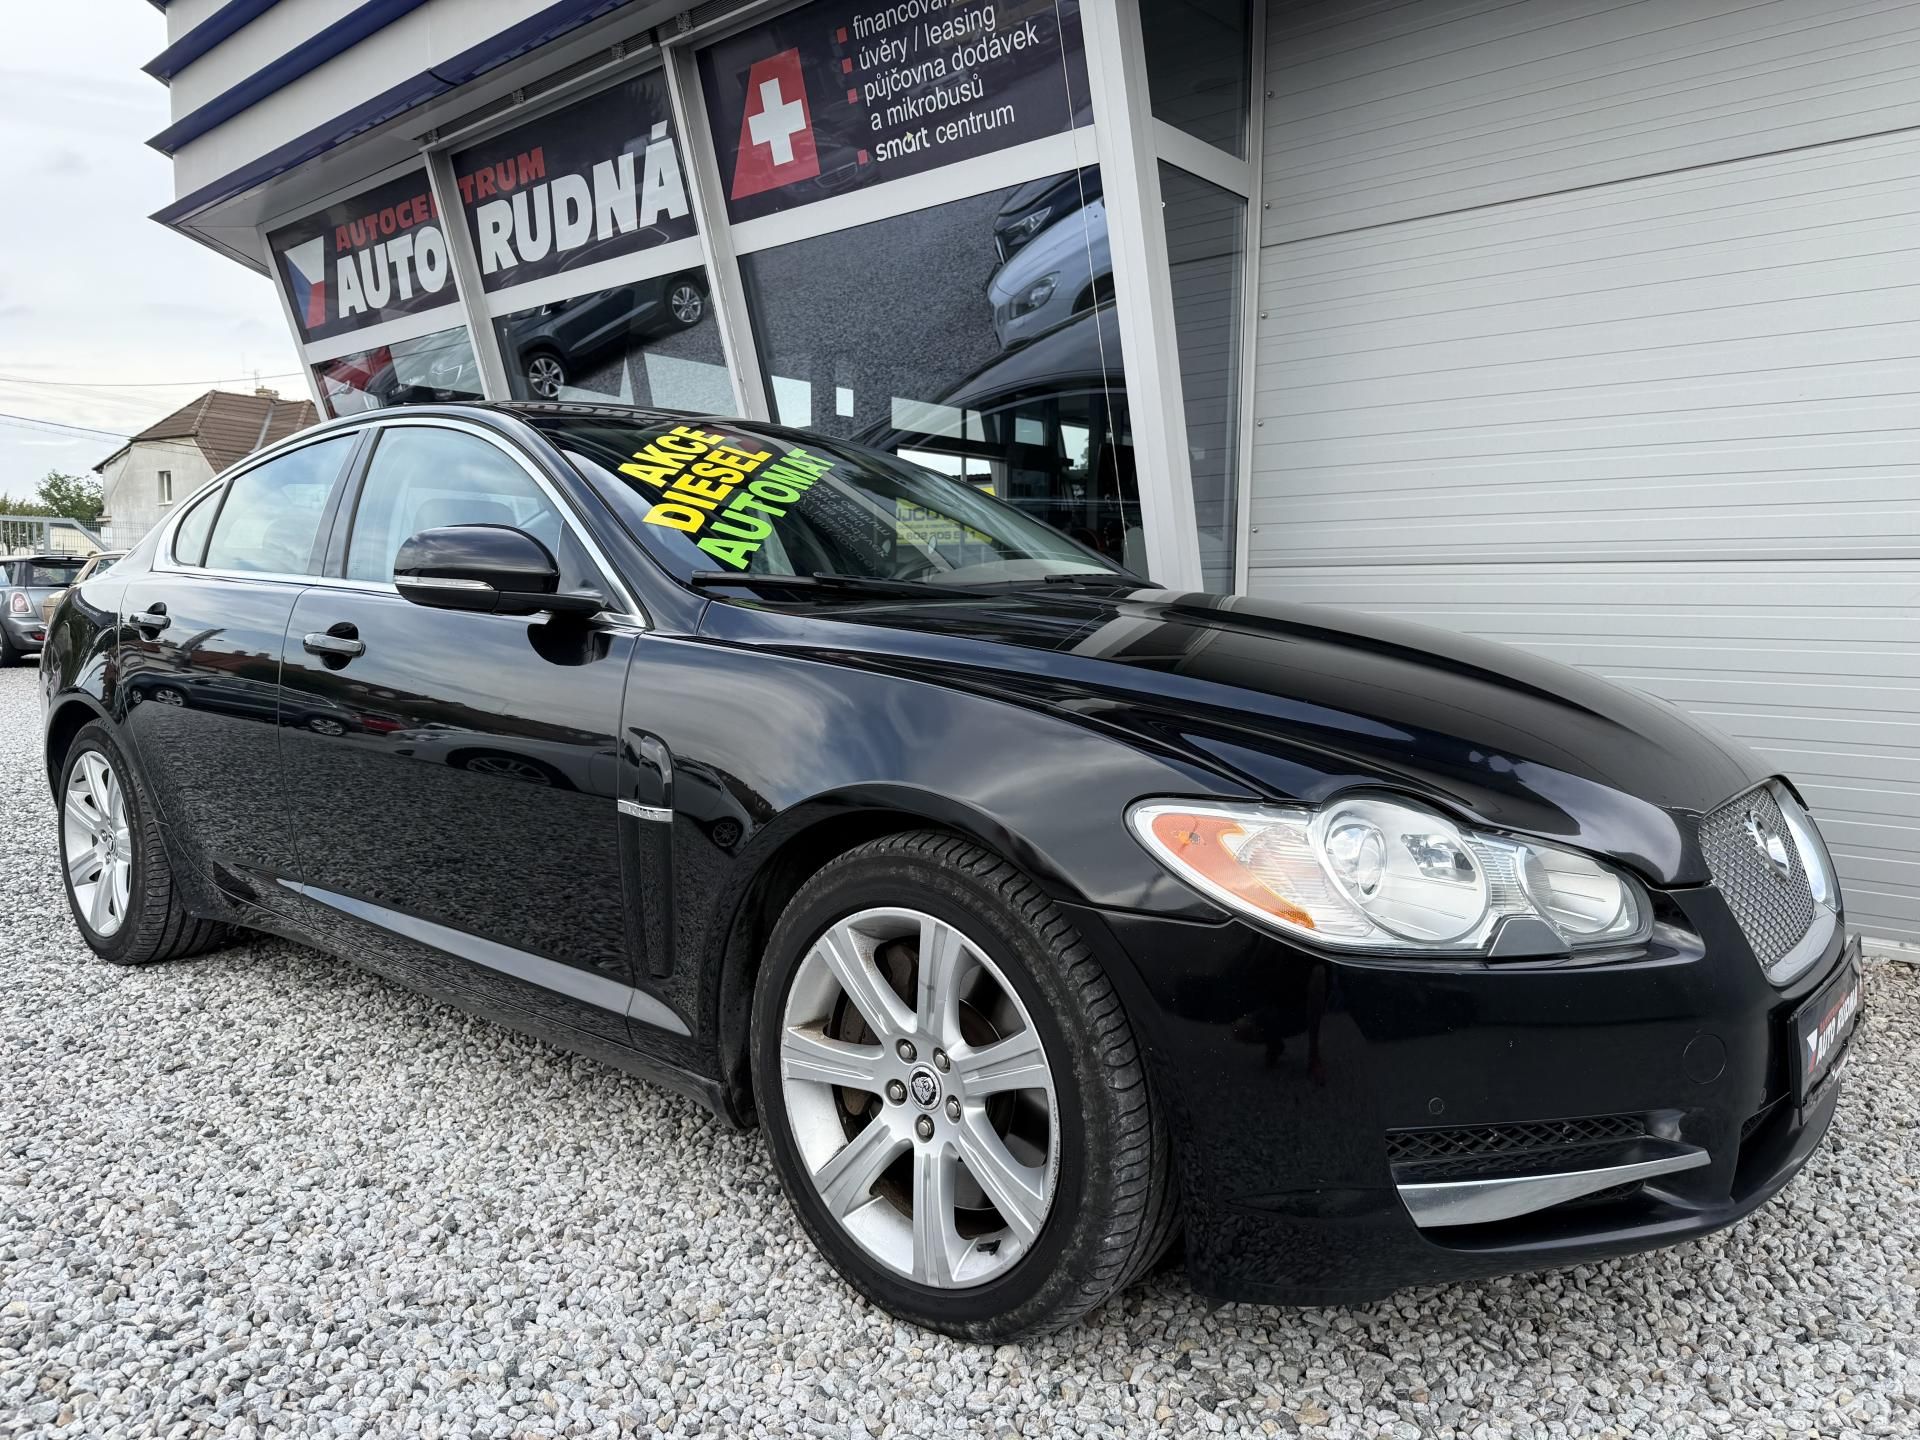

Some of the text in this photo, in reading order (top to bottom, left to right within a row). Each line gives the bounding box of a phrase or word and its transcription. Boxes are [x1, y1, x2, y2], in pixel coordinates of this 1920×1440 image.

[853, 0, 961, 40] financov
[859, 37, 907, 70] úvěry
[924, 4, 997, 47] leasing
[864, 21, 1040, 107] půjčovna dodávek
[870, 73, 984, 131] a mikrobusů
[875, 102, 1015, 162] smart centrum
[336, 119, 690, 319] AUTO RUDNÁ
[617, 425, 726, 488] AKCE
[642, 445, 773, 533] DIESEL
[697, 447, 836, 570] AUTOMAT
[1815, 1016, 1836, 1067] AUTO
